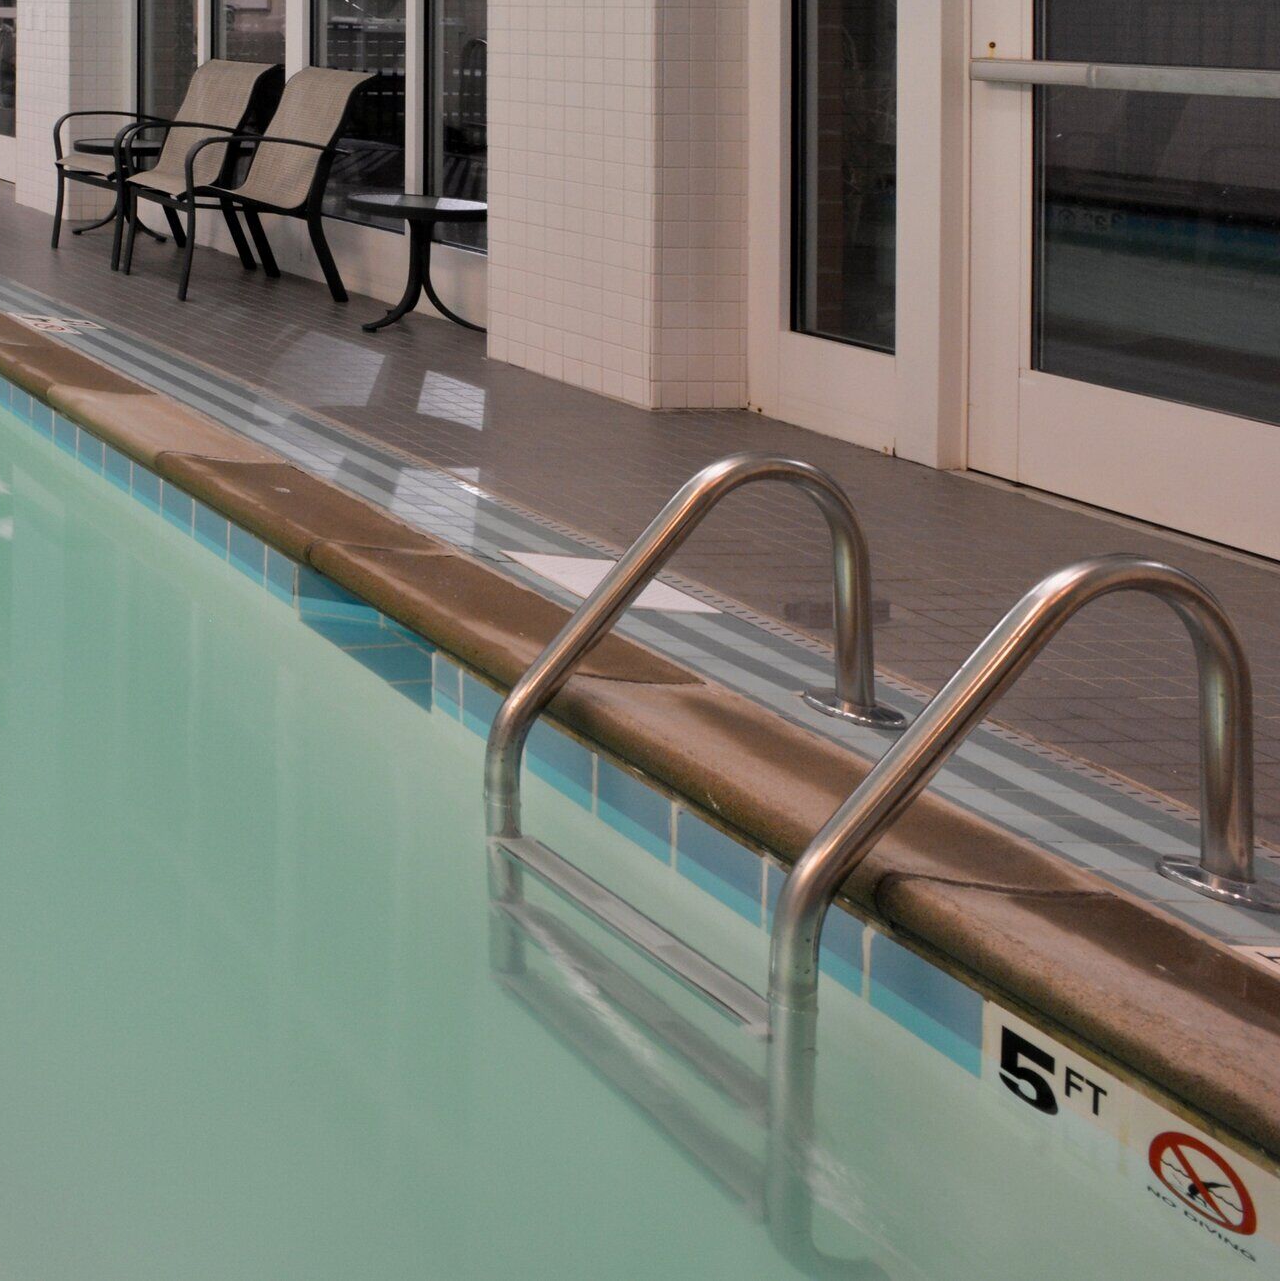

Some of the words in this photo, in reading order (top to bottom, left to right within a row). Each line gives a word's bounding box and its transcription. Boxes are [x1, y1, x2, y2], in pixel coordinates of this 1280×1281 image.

[998, 1025, 1059, 1116] 5
[1064, 1066, 1108, 1116] FT
[1146, 1185, 1177, 1208] NO
[1183, 1209, 1257, 1263] DIVING
